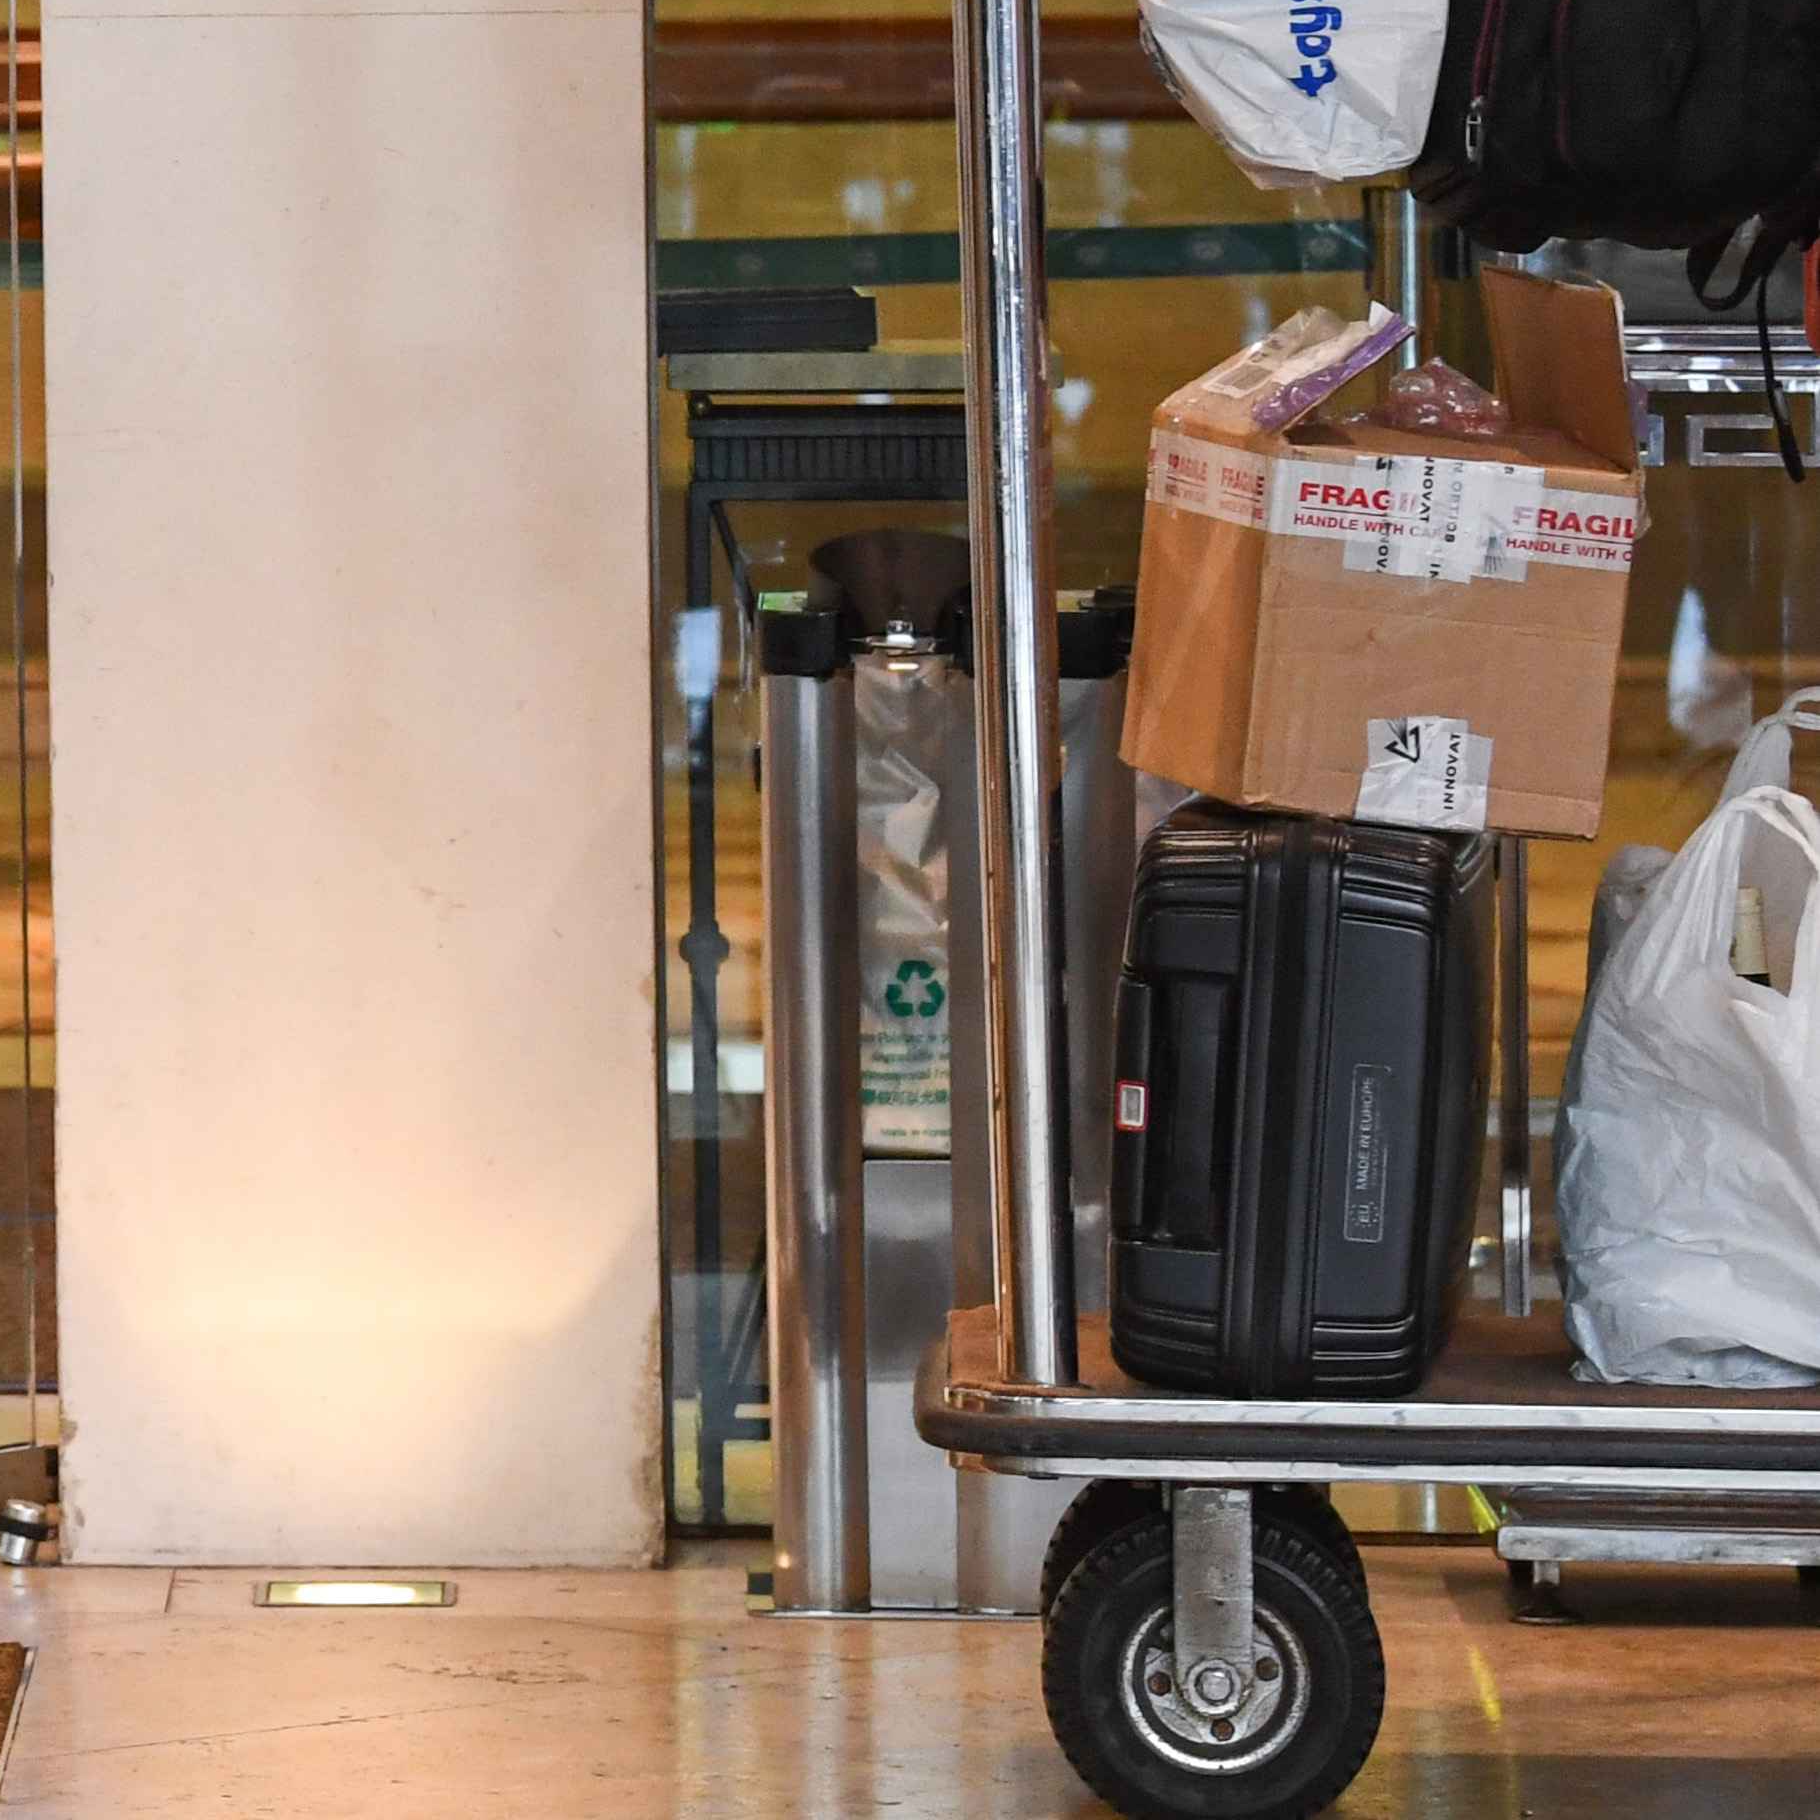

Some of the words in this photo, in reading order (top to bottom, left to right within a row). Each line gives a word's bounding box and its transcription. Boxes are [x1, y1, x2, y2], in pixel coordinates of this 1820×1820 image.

[1293, 511, 1358, 532] HANDLE
[1363, 520, 1404, 539] WITH
[1505, 537, 1572, 557] HANDLE
[1576, 544, 1619, 561] WITH
[1441, 733, 1461, 811] INNOVAT
[1360, 1077, 1374, 1132] EUROPE
[1359, 1133, 1372, 1149] IN
[1355, 1151, 1371, 1190] MADE
[1359, 1204, 1370, 1223] EU
